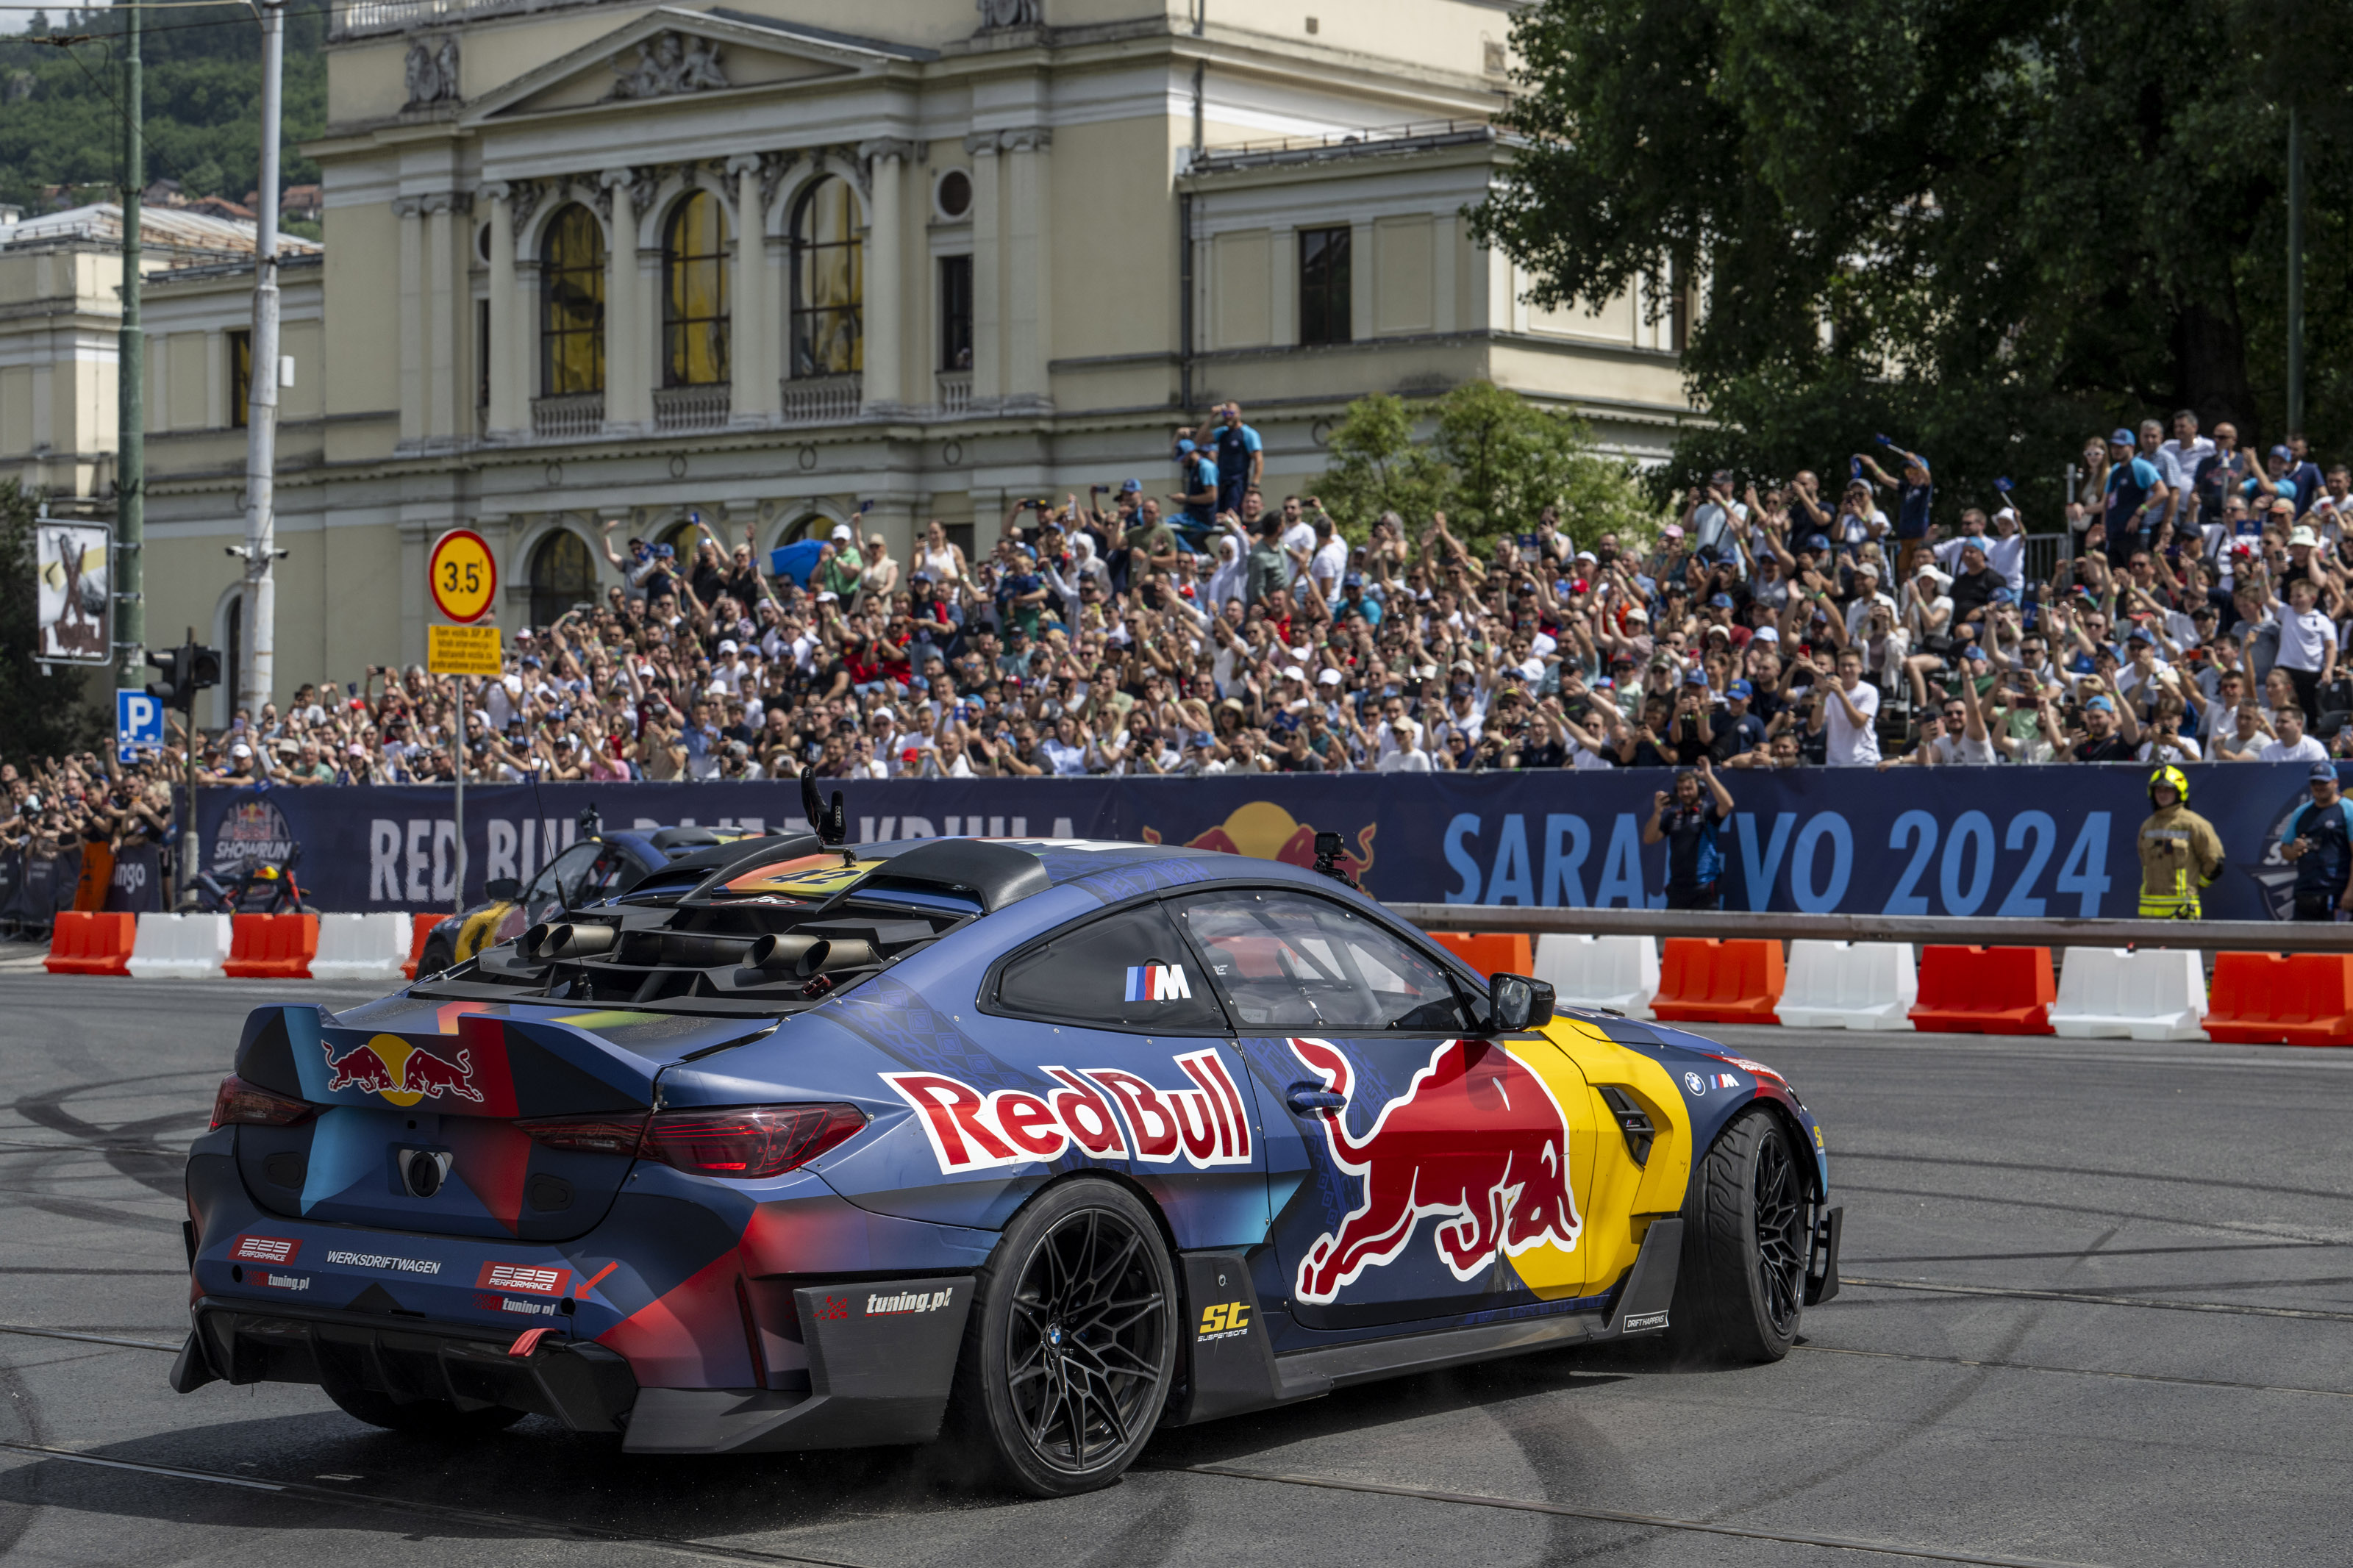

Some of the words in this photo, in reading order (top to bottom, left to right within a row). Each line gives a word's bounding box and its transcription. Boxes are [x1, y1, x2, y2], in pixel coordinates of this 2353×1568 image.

[128, 696, 154, 736] P
[214, 840, 293, 860] SHOWRUN
[369, 819, 469, 902] RED
[1443, 811, 1854, 914] SARAVO
[1881, 809, 2112, 918] 2024
[238, 1250, 287, 1261] PERFORMANCE
[241, 1238, 292, 1254] 229
[326, 1250, 441, 1275] WERKSDRIFTWAGEN
[488, 1278, 554, 1291] PERFORMANCE
[492, 1265, 559, 1284] 229
[865, 1287, 953, 1314] tuning.pl
